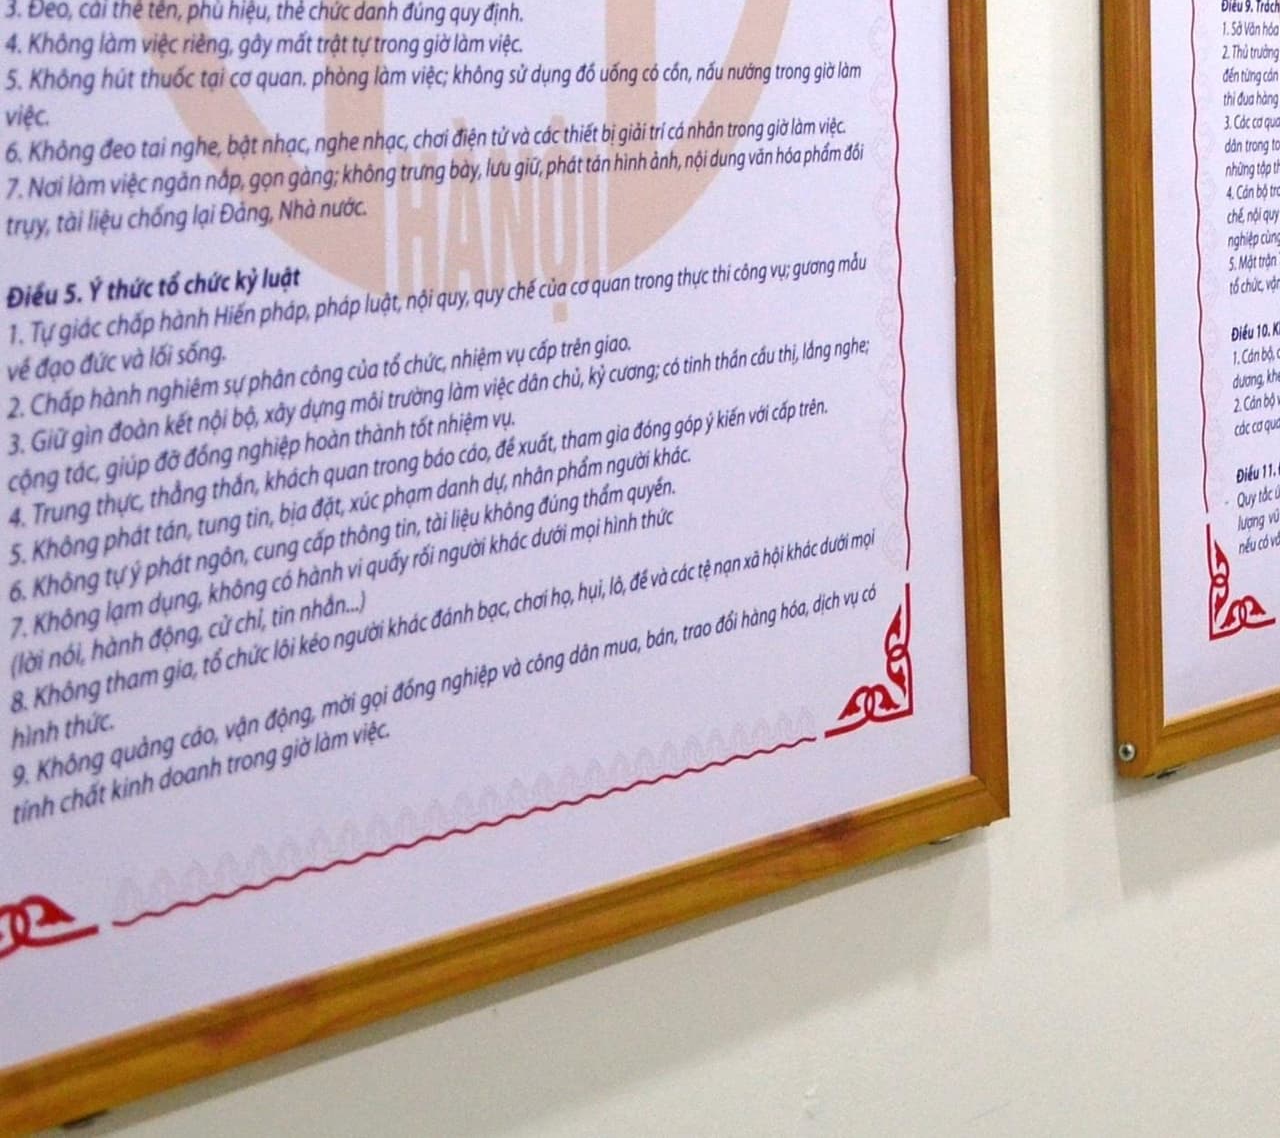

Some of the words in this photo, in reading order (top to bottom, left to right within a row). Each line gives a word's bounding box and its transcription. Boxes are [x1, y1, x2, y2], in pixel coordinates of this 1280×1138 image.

[62, 281, 83, 306] 5.
[88, 275, 104, 303] Ý
[106, 276, 155, 302] thức
[157, 269, 182, 298] tổ
[182, 270, 232, 296] chức
[233, 265, 259, 297] kỷ
[260, 265, 302, 294] luật
[1256, 322, 1272, 339] 10.
[1261, 462, 1277, 479] 11.
